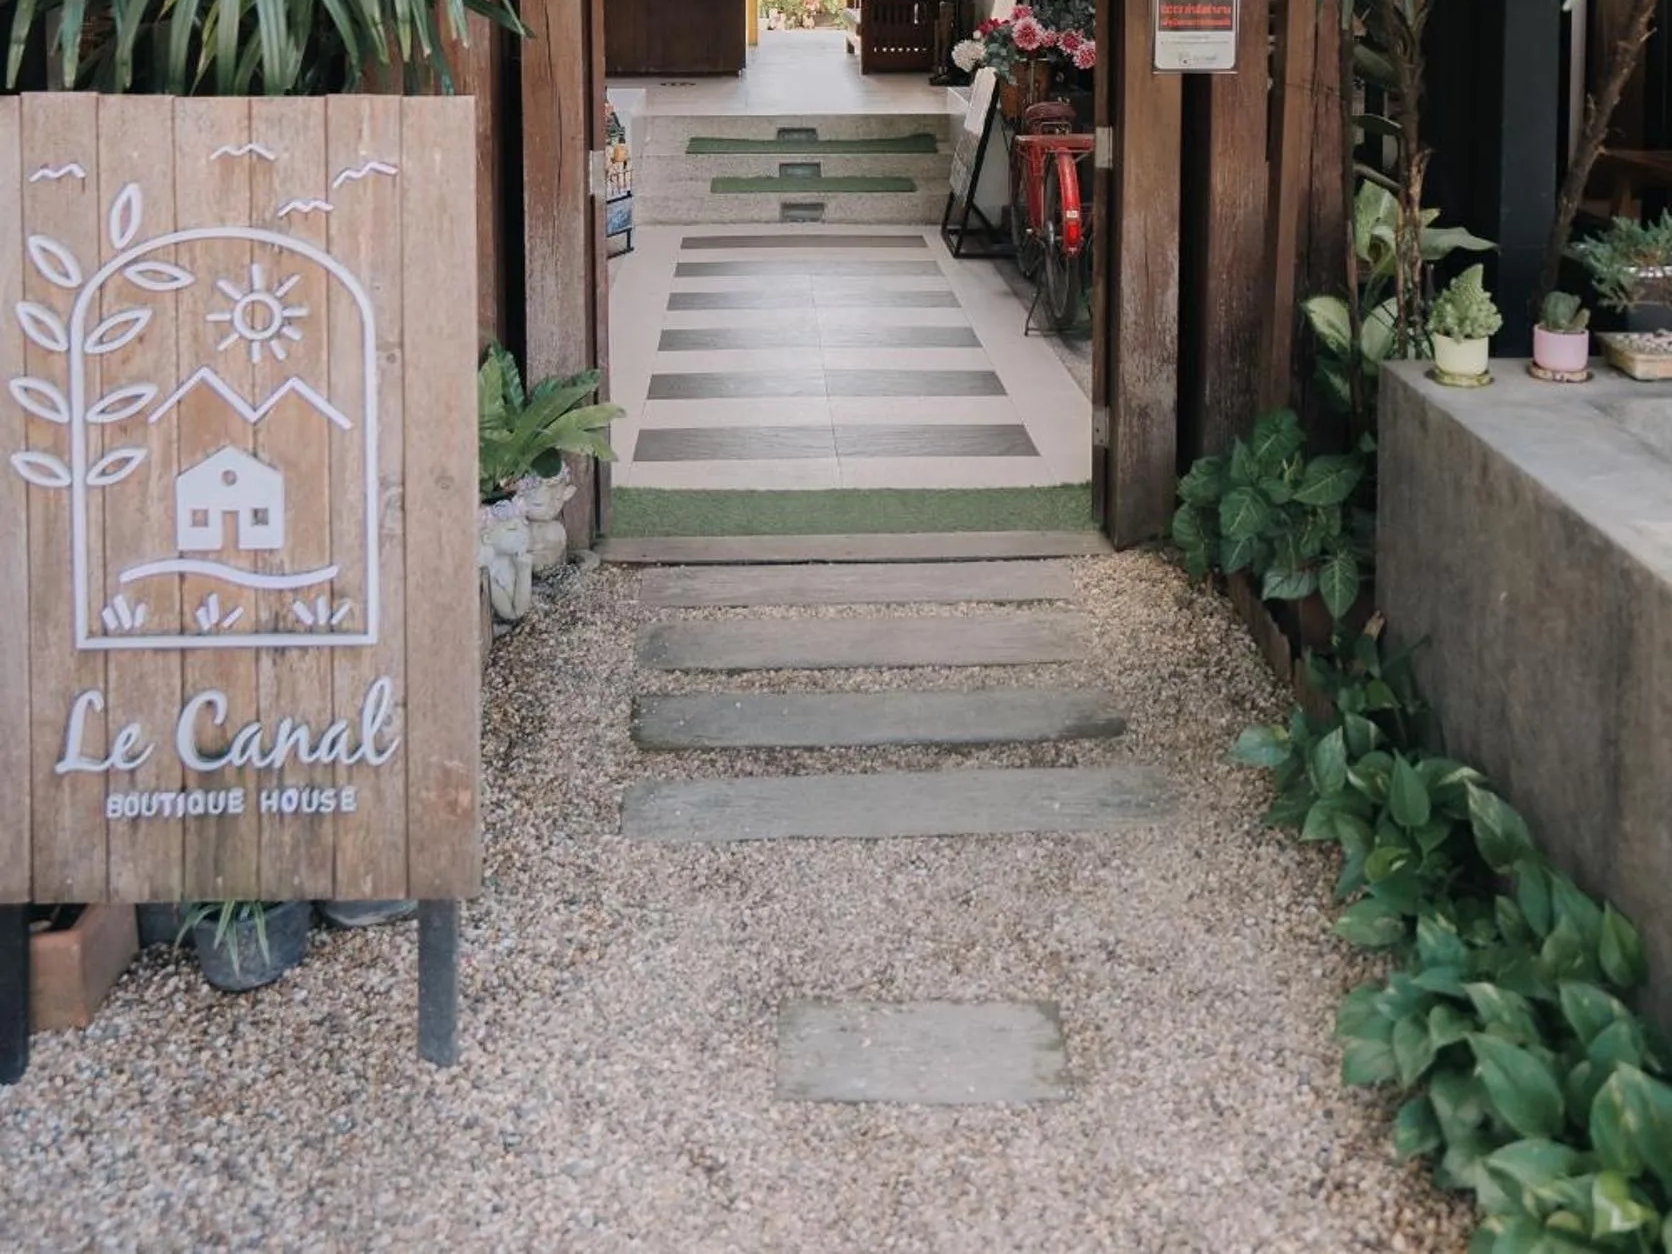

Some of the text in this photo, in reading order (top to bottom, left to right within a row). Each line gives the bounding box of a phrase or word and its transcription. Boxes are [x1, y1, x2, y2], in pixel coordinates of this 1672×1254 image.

[54, 675, 401, 775] Le Canal
[106, 785, 359, 819] BOUTIQUE HOUSE
